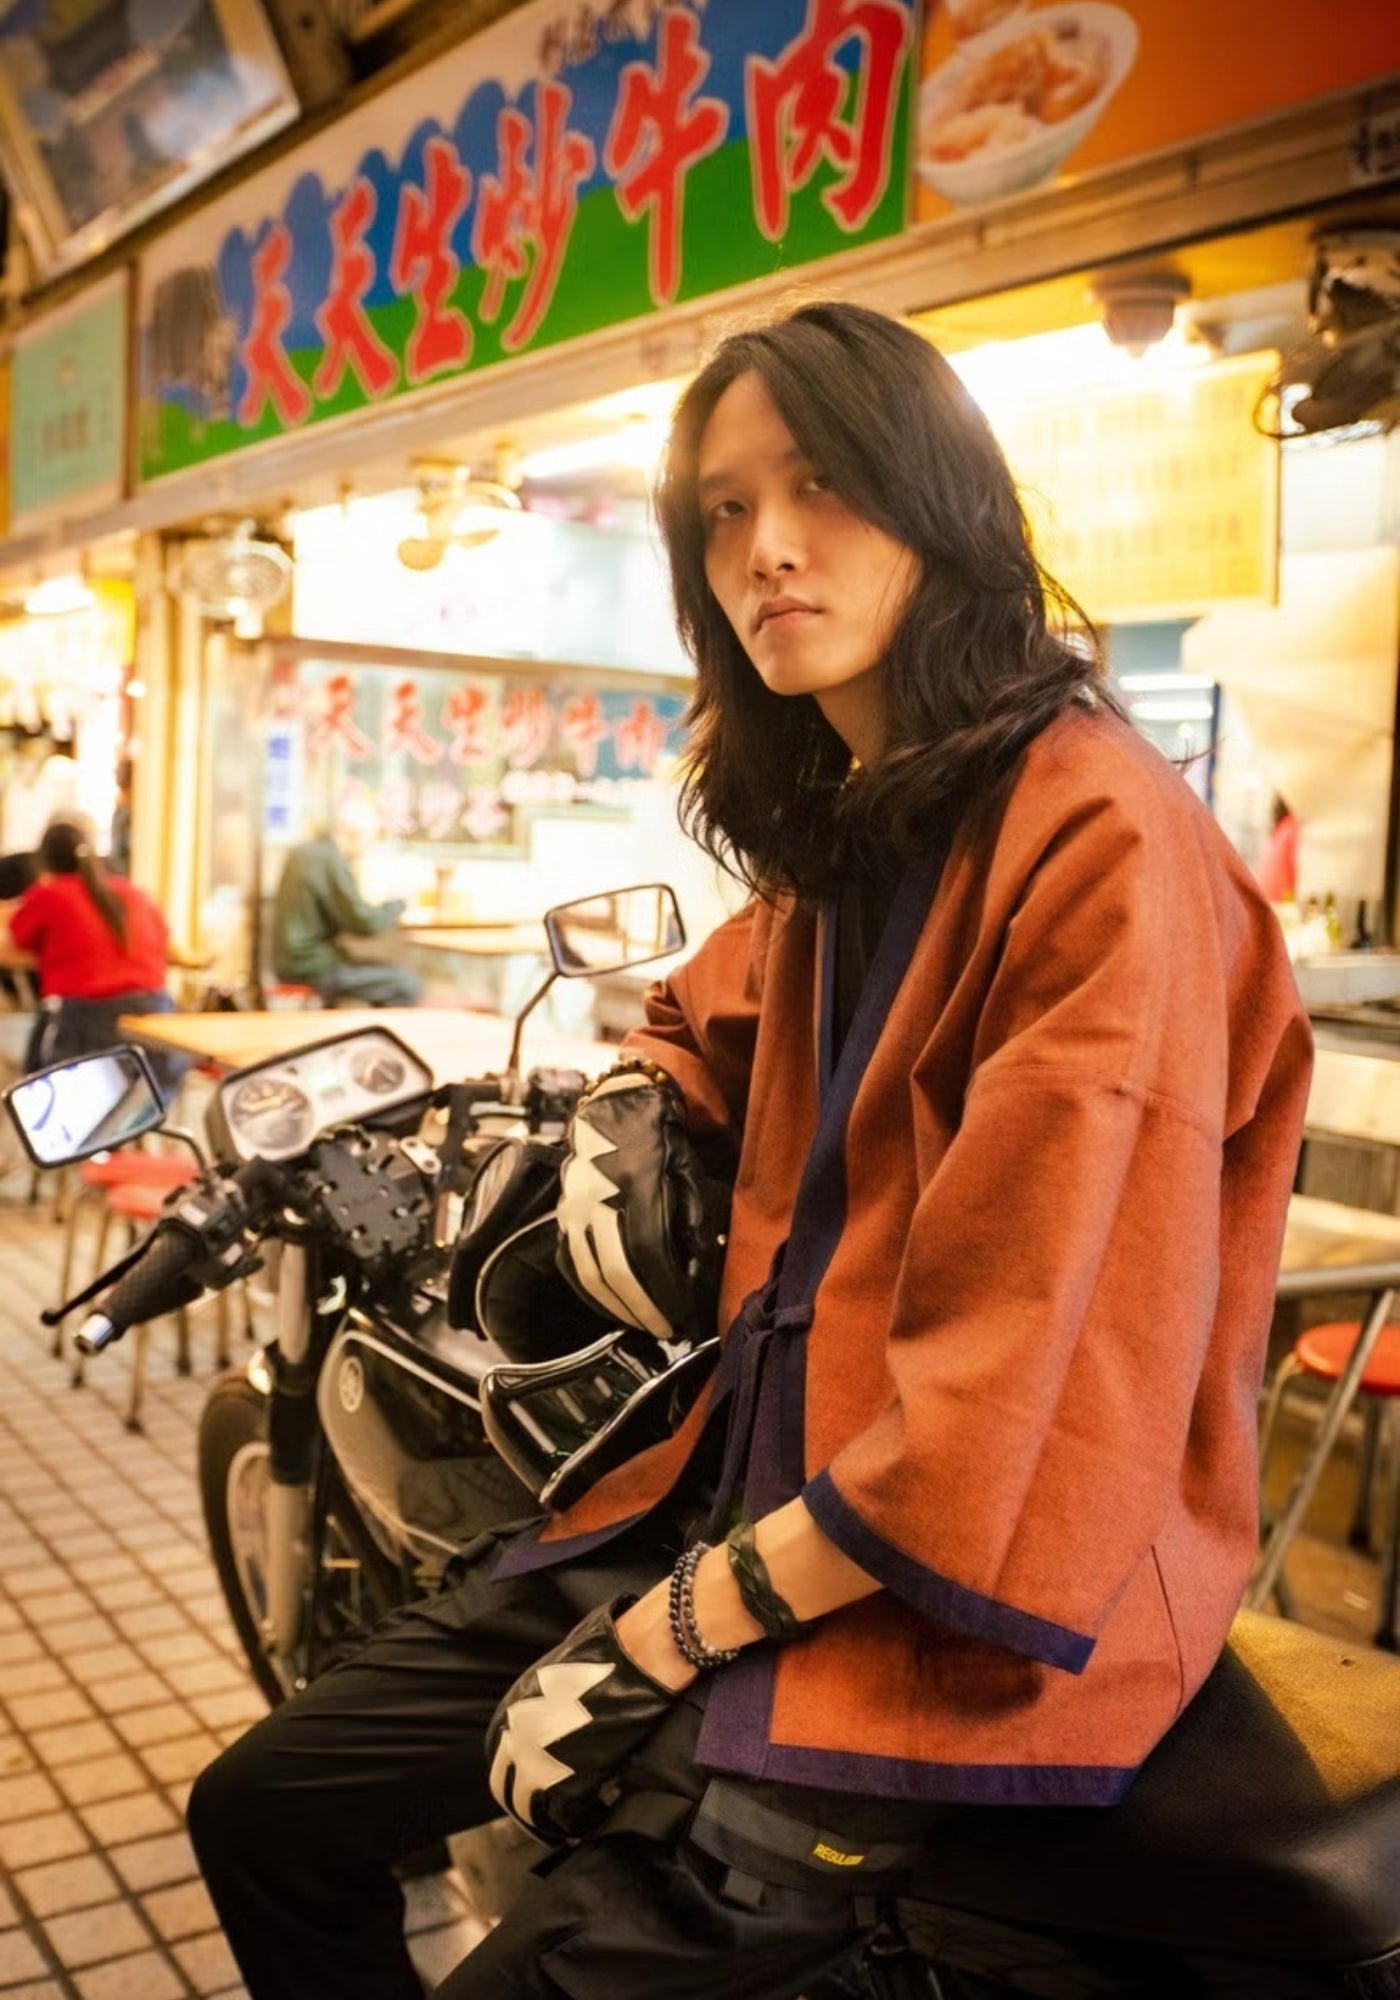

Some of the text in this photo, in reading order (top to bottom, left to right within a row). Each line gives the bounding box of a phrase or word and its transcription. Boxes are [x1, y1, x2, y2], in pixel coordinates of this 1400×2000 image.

[237, 0, 908, 430] 天天生炒牛肉
